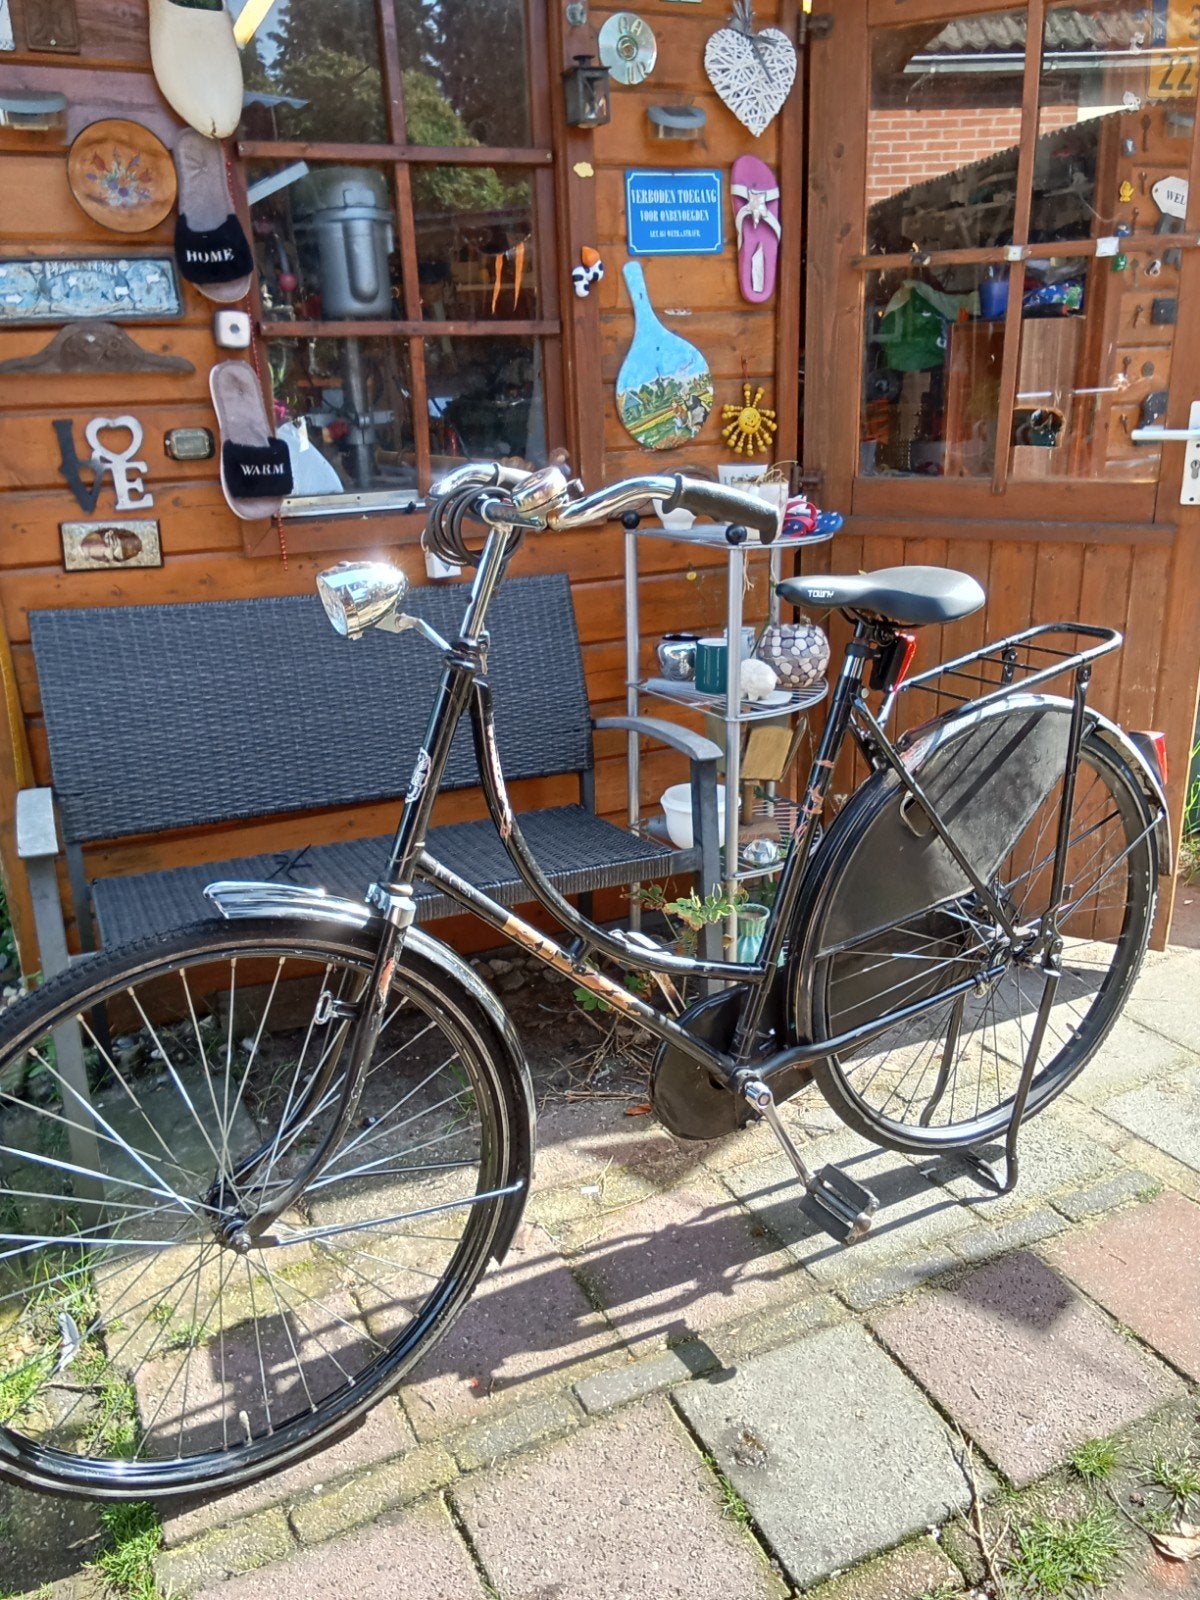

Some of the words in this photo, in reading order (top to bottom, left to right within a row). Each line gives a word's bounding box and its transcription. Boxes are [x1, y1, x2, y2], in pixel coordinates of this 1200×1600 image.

[1158, 53, 1193, 91] 22
[631, 189, 676, 204] VERBODEN
[677, 189, 717, 203] TOEGANG
[640, 210, 659, 222] VOOR
[186, 248, 235, 263] HOME
[240, 463, 285, 476] WARM
